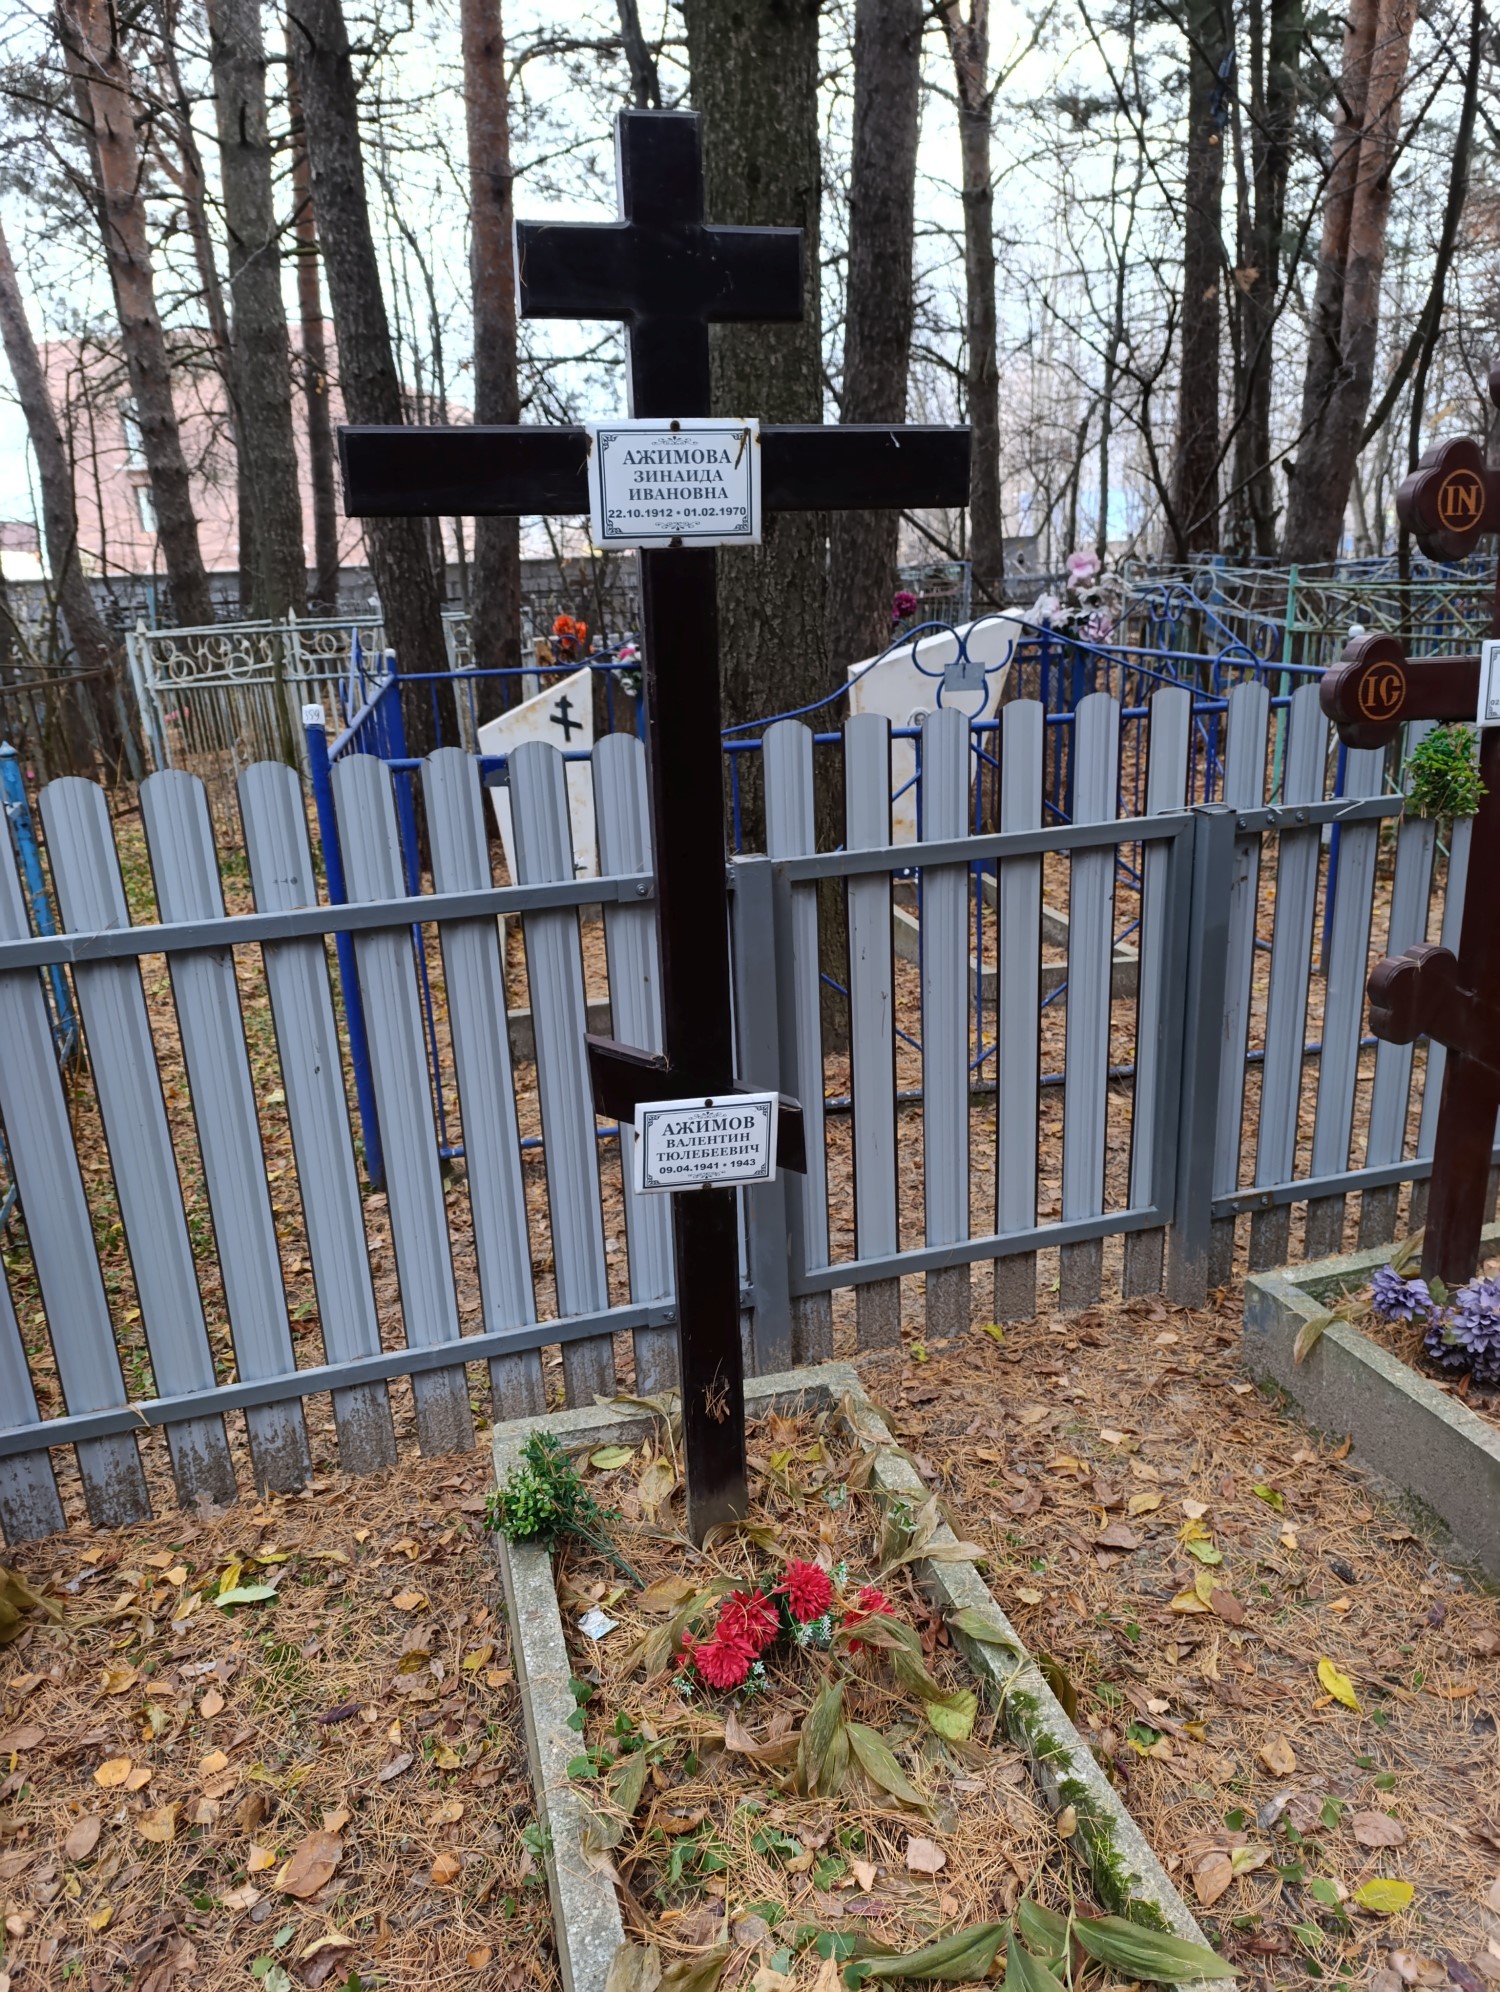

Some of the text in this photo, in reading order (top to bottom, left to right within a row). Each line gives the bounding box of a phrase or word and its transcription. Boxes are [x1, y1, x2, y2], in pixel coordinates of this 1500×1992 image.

[622, 448, 732, 465] АЖИМОВА
[633, 469, 724, 483] ЗИНАИДА
[628, 486, 729, 501] ИВАНОВНА
[608, 506, 747, 519] 22.10.1912 01.02.1970
[661, 1115, 755, 1136] АЖИМОВ
[666, 1132, 750, 1149] ВАЛЕНТИН
[656, 1144, 760, 1162] ТЮЛЕБЕЕВИЧ
[659, 1158, 756, 1175] 09.04.1941 1943
